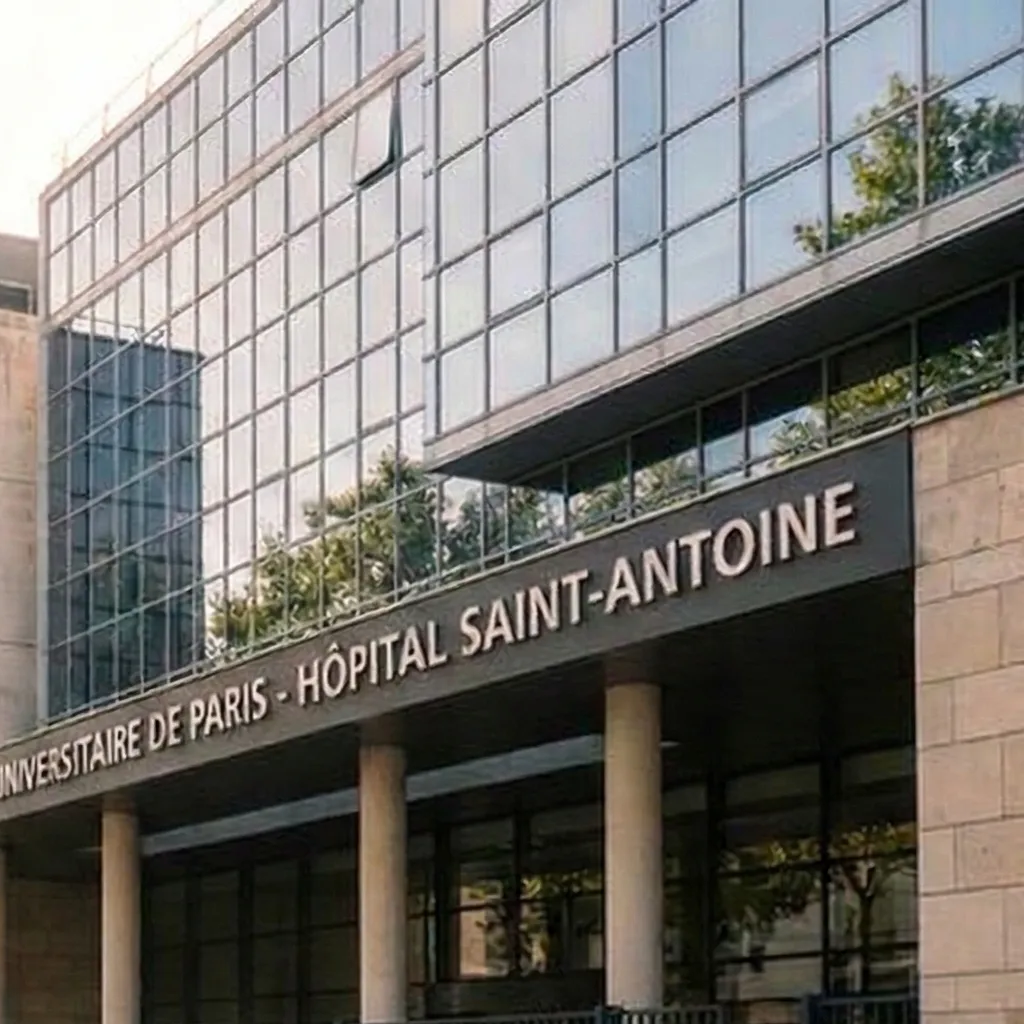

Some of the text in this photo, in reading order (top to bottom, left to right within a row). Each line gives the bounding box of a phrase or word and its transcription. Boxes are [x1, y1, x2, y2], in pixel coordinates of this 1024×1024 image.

[149, 704, 182, 751] DE
[189, 676, 267, 740] PARIS
[295, 619, 448, 708] HÔPITAL
[460, 481, 855, 657] SAINT-ANTOINE
